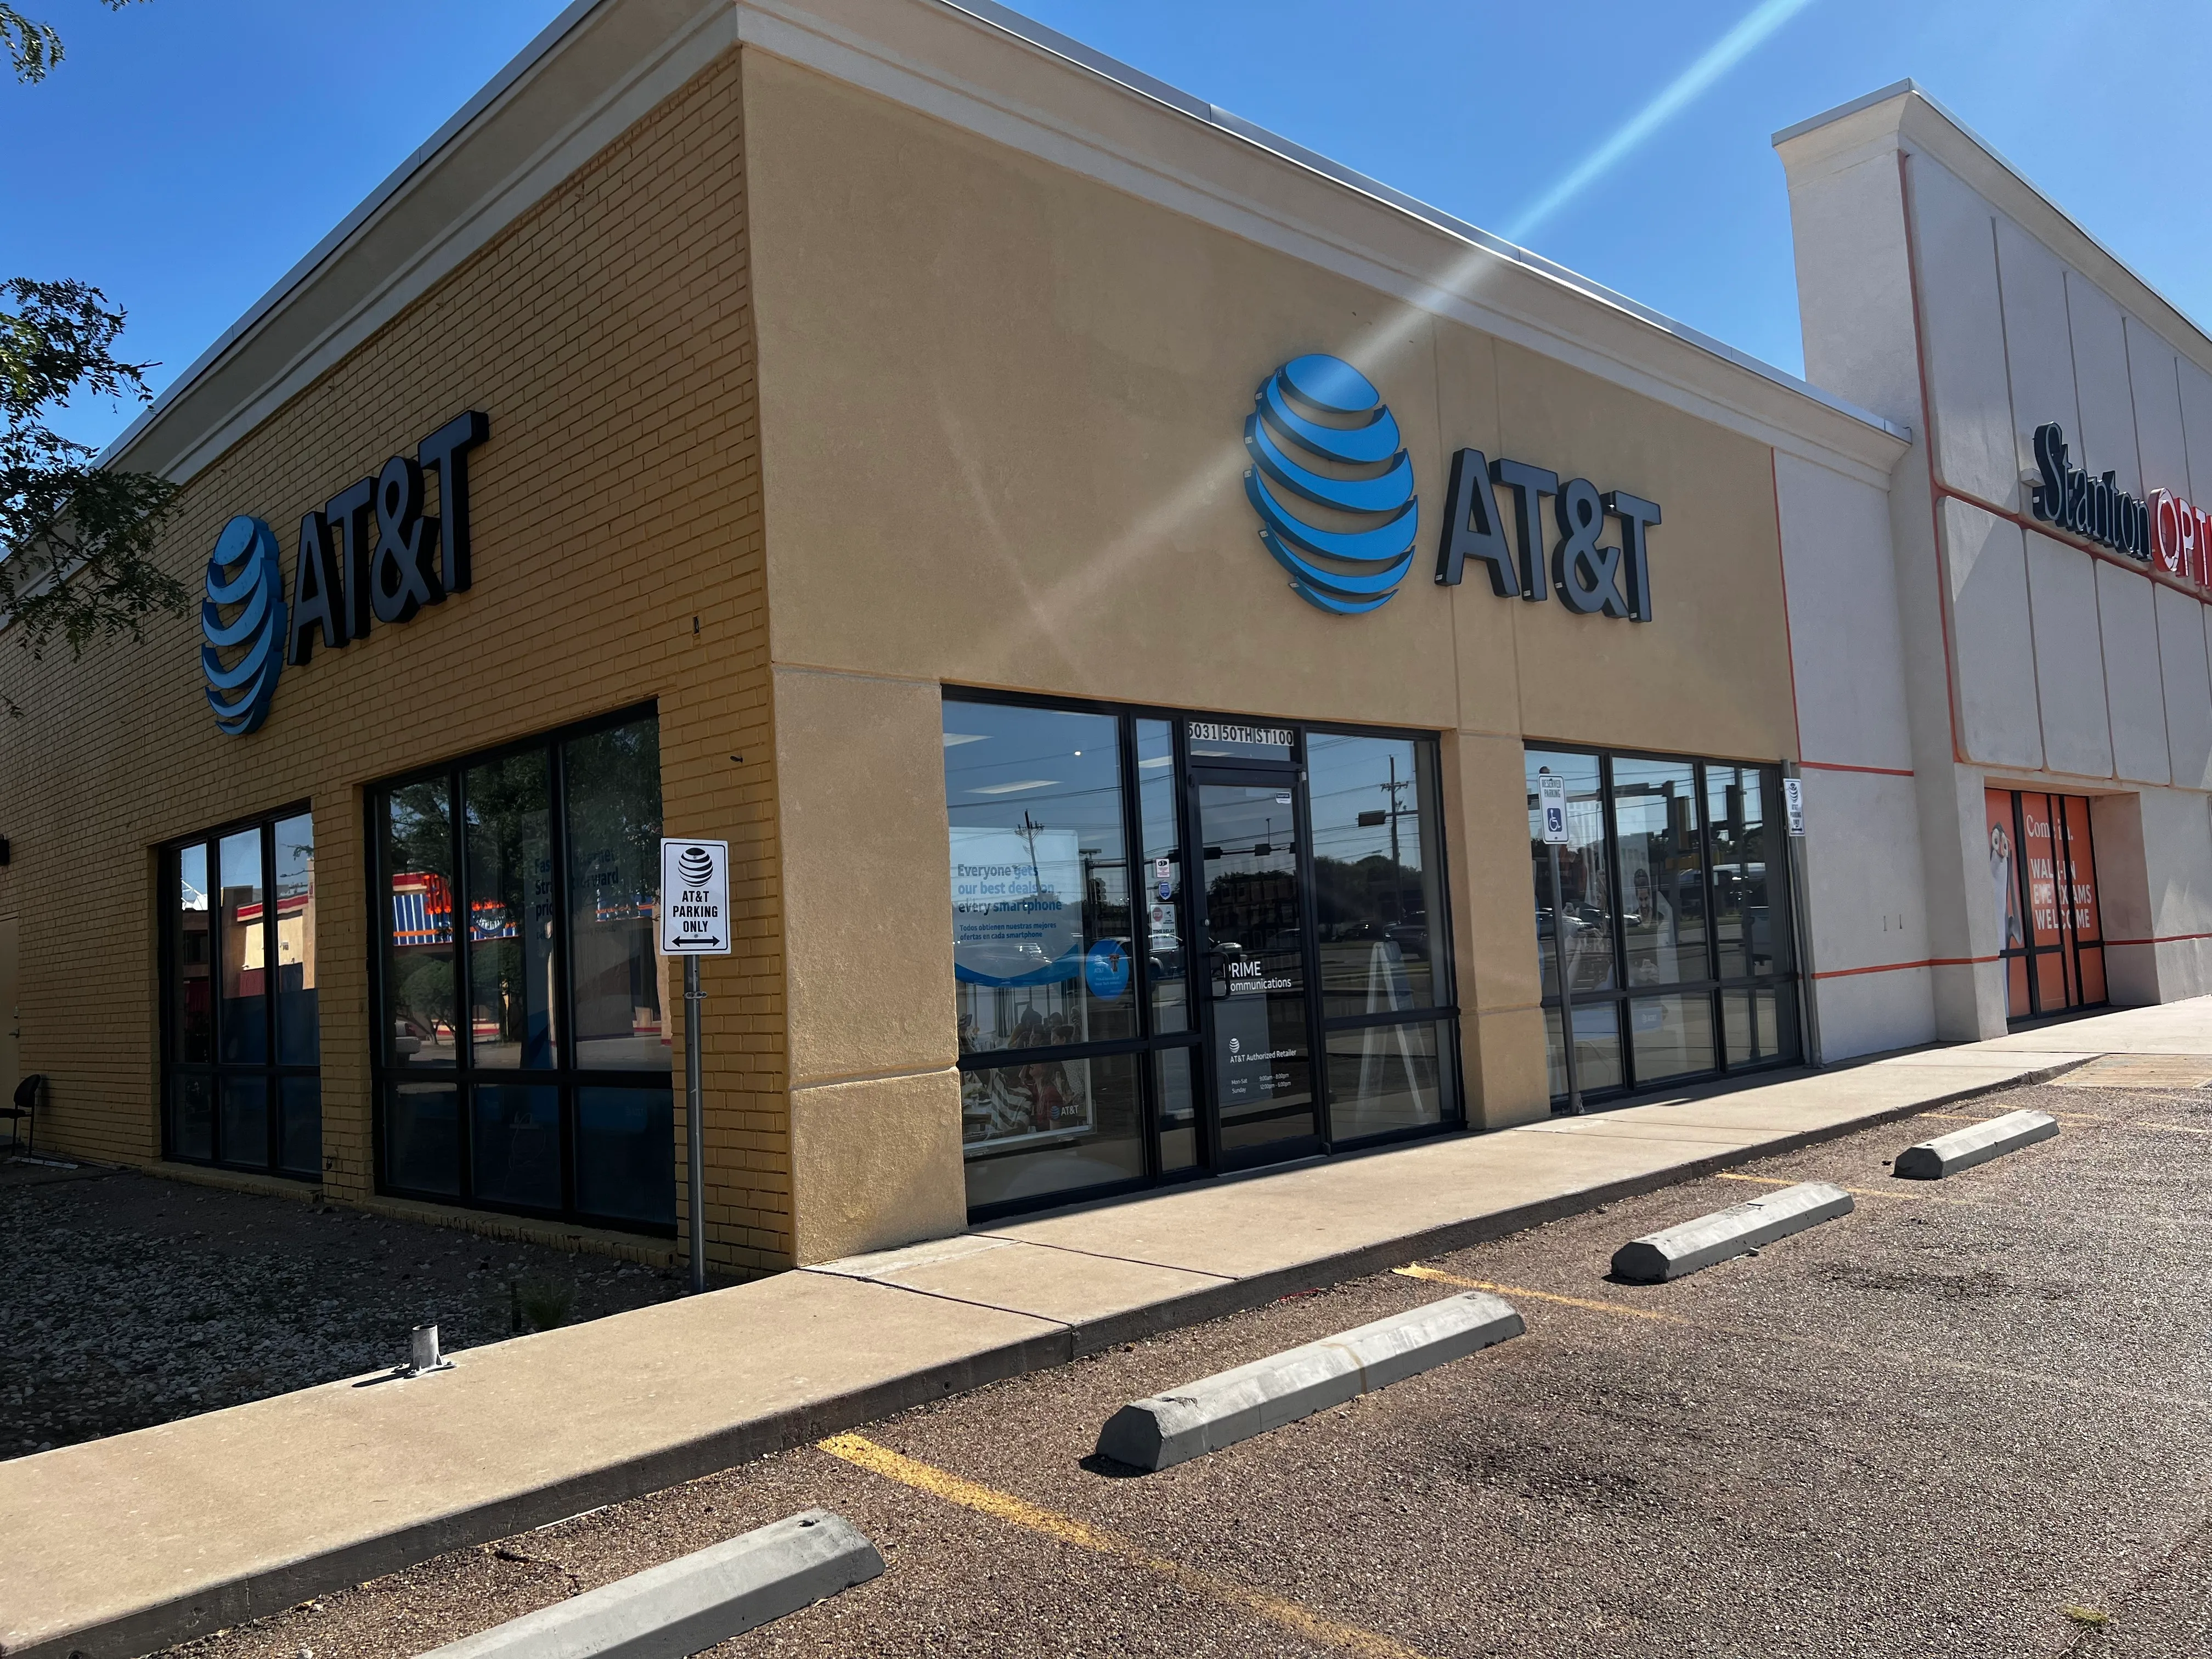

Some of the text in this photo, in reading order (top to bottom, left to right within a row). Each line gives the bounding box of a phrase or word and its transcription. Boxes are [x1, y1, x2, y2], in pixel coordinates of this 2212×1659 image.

[2032, 421, 2212, 591] Stanton OPT
[287, 410, 489, 665] AT&T
[1435, 447, 1661, 623] AT&T
[1189, 723, 1293, 745] 5031 50TH ST 100
[1542, 779, 1562, 788] RESERVED
[1544, 789, 1561, 798] PARKING
[957, 864, 1039, 880] Everyone gets
[958, 881, 1054, 895] our best deals on
[2033, 883, 2092, 905] EYE XAMS
[681, 890, 709, 902] AT&T
[673, 905, 718, 918] PARKING
[958, 898, 1063, 916] every smartphone
[682, 921, 708, 933] ONLY
[979, 923, 1005, 931] obtienen
[1033, 922, 1057, 930] mejores
[1006, 931, 1043, 940] smartphone
[1224, 977, 1292, 992] ommunications
[1230, 1048, 1297, 1063] AT&T Authorized Retailer
[1060, 1104, 1080, 1116] AT&T
